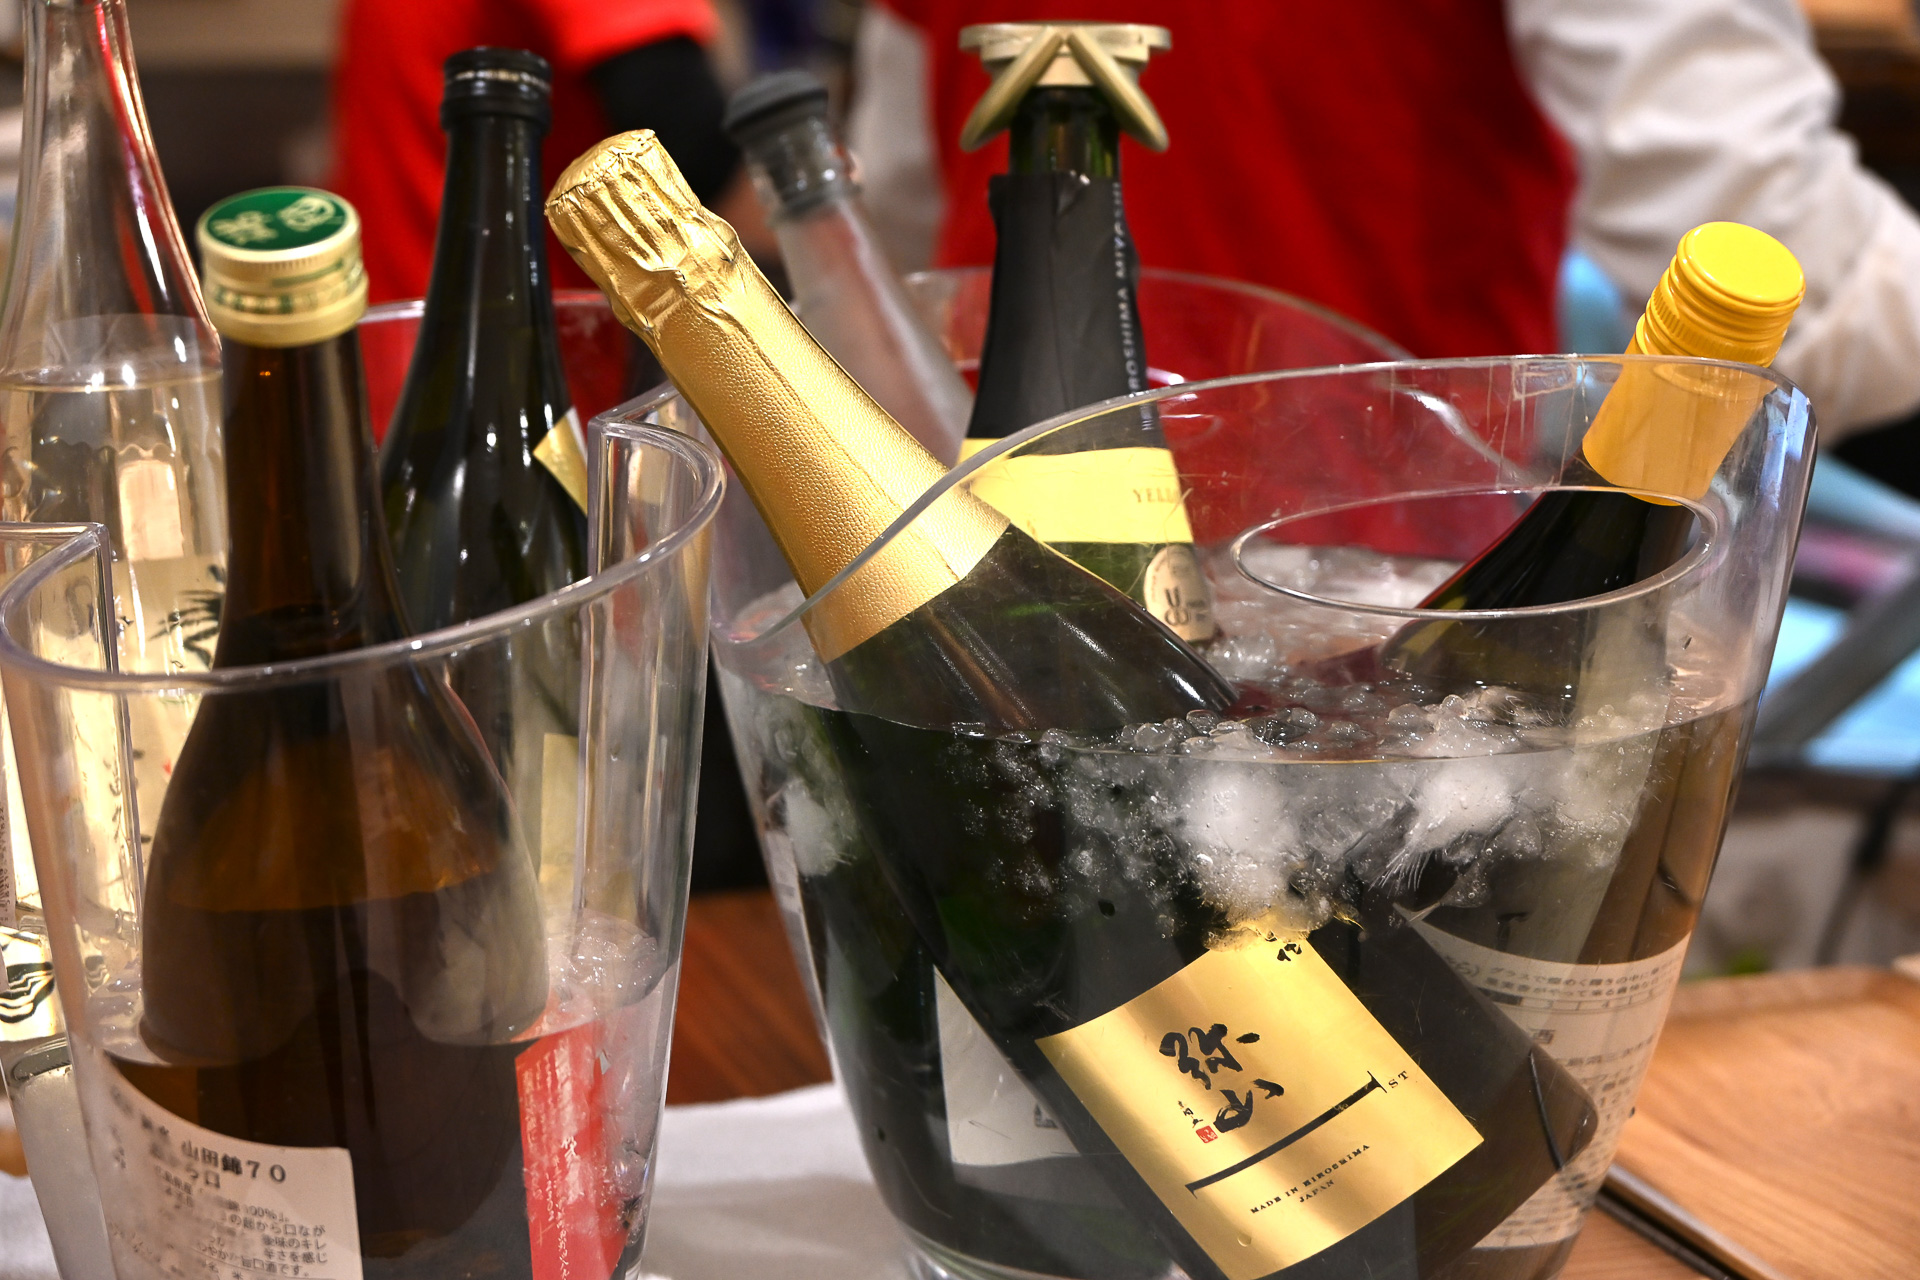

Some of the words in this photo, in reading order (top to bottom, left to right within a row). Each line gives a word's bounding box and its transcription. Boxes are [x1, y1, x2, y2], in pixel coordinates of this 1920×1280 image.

[1388, 1070, 1409, 1089] ST
[1250, 1196, 1282, 1214] MADE
[1285, 1186, 1299, 1197] IN
[1303, 1144, 1370, 1187] HIROSHIMA
[1300, 1179, 1335, 1203] JAPAN
